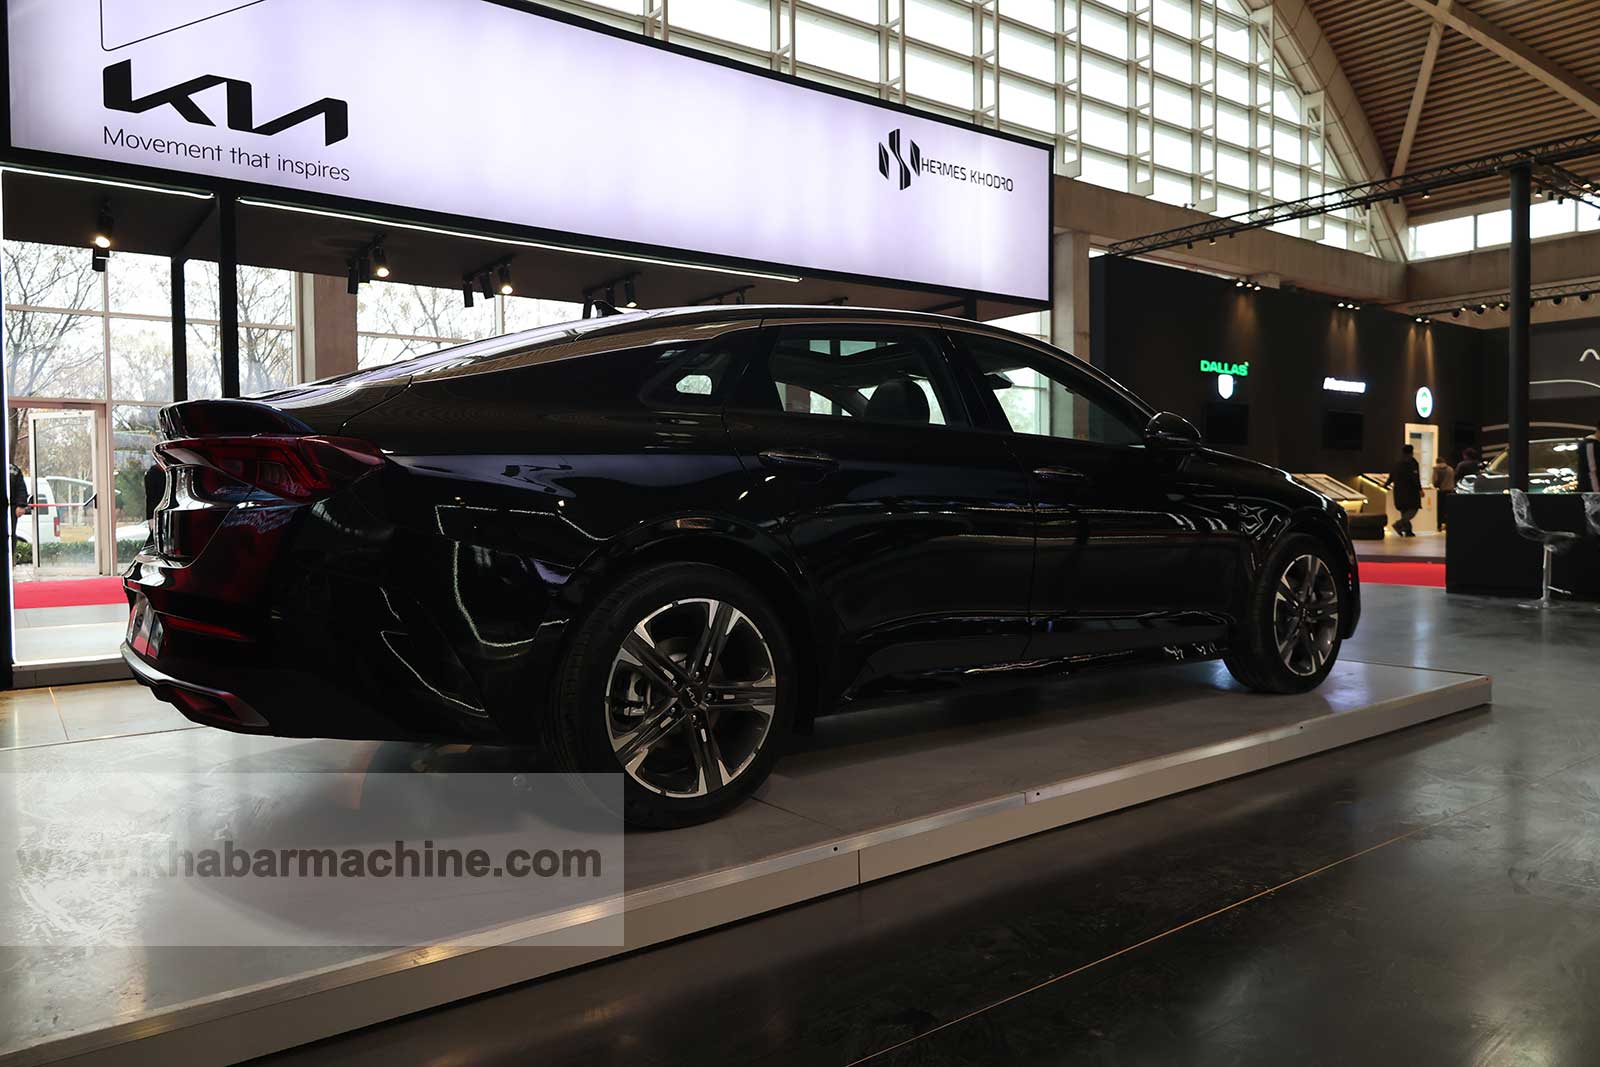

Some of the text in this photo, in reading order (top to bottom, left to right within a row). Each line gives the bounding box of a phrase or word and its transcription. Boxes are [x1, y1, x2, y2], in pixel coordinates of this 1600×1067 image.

[102, 58, 349, 147] KIA
[103, 125, 350, 182] Movement that inspires
[921, 157, 1014, 192] HERMES KHODRO
[1200, 359, 1248, 376] DALLAS
